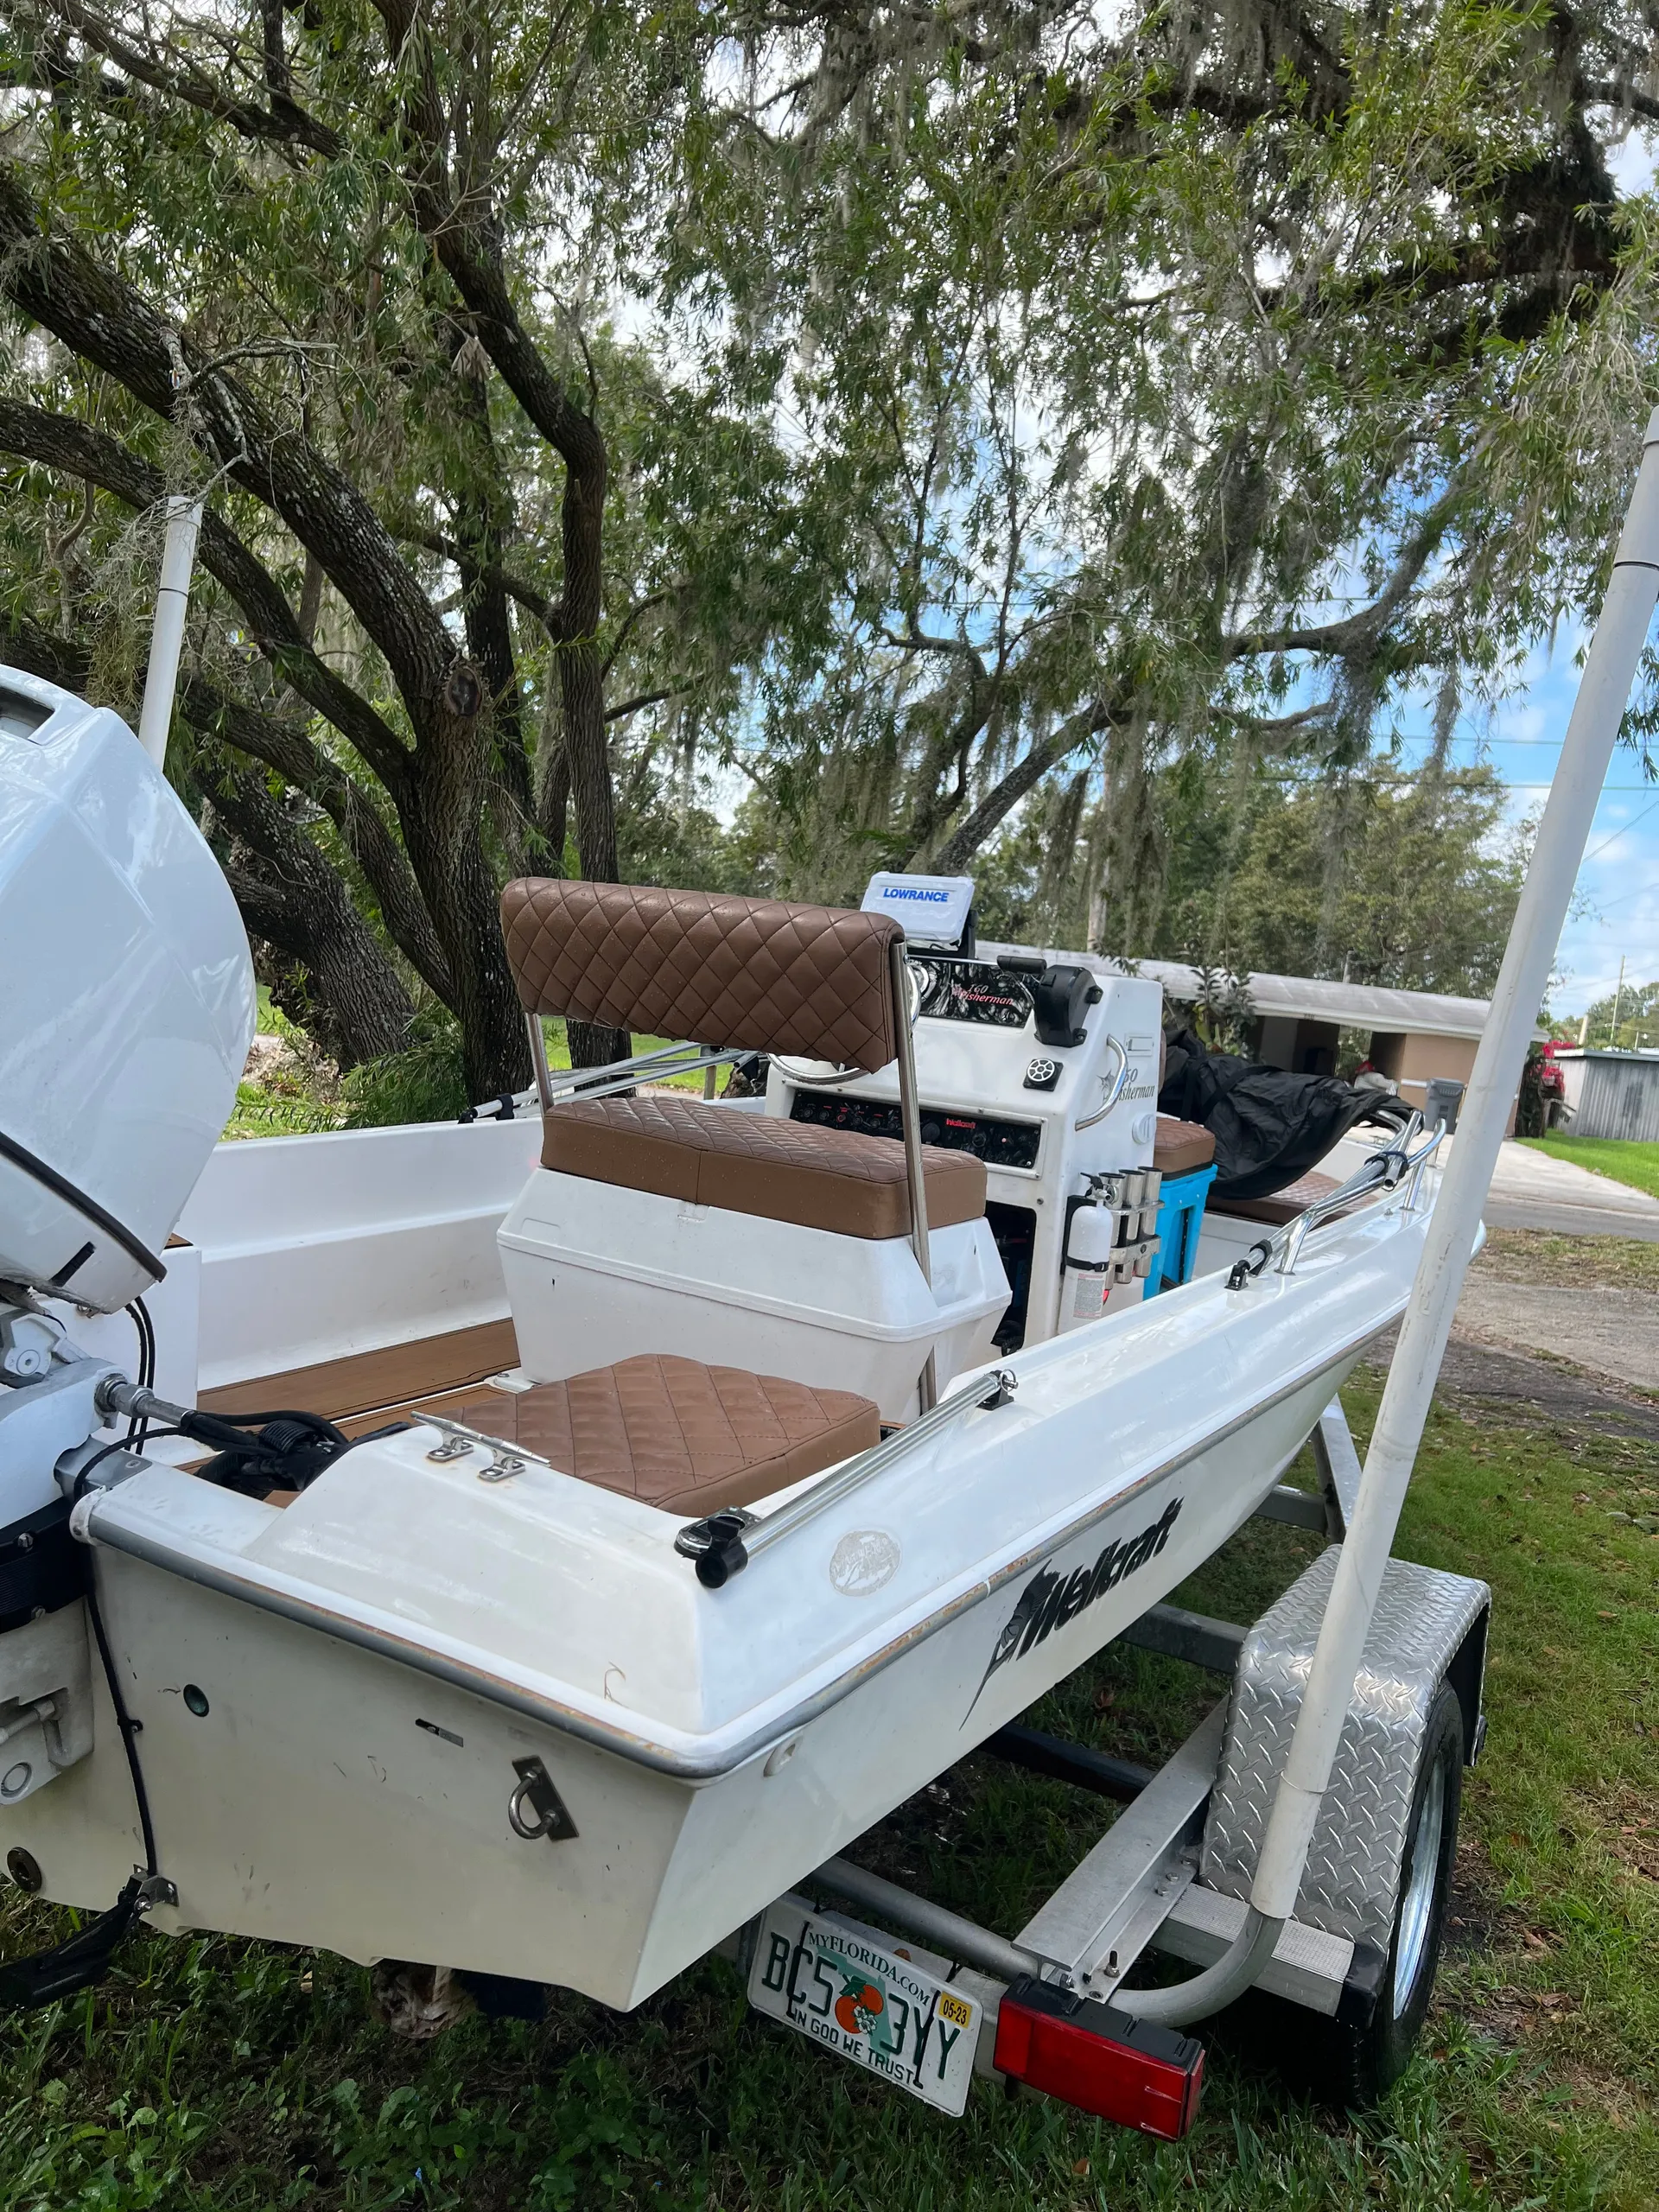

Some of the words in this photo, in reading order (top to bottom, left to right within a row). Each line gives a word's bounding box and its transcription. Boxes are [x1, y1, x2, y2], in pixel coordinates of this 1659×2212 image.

[883, 887, 950, 902] LOWRANCE
[958, 990, 1014, 1005] Fisherman
[968, 983, 988, 994] 160
[1118, 1083, 1155, 1101] isherman
[1015, 1496, 1185, 1662] Wellcraft
[808, 1931, 931, 2006] MYFLORIDA.COM
[943, 1999, 968, 2024] 05-23
[792, 2007, 807, 2027] IN
[810, 2018, 839, 2044] GOD
[842, 2037, 863, 2059] WE
[867, 2047, 915, 2084] TRUST
